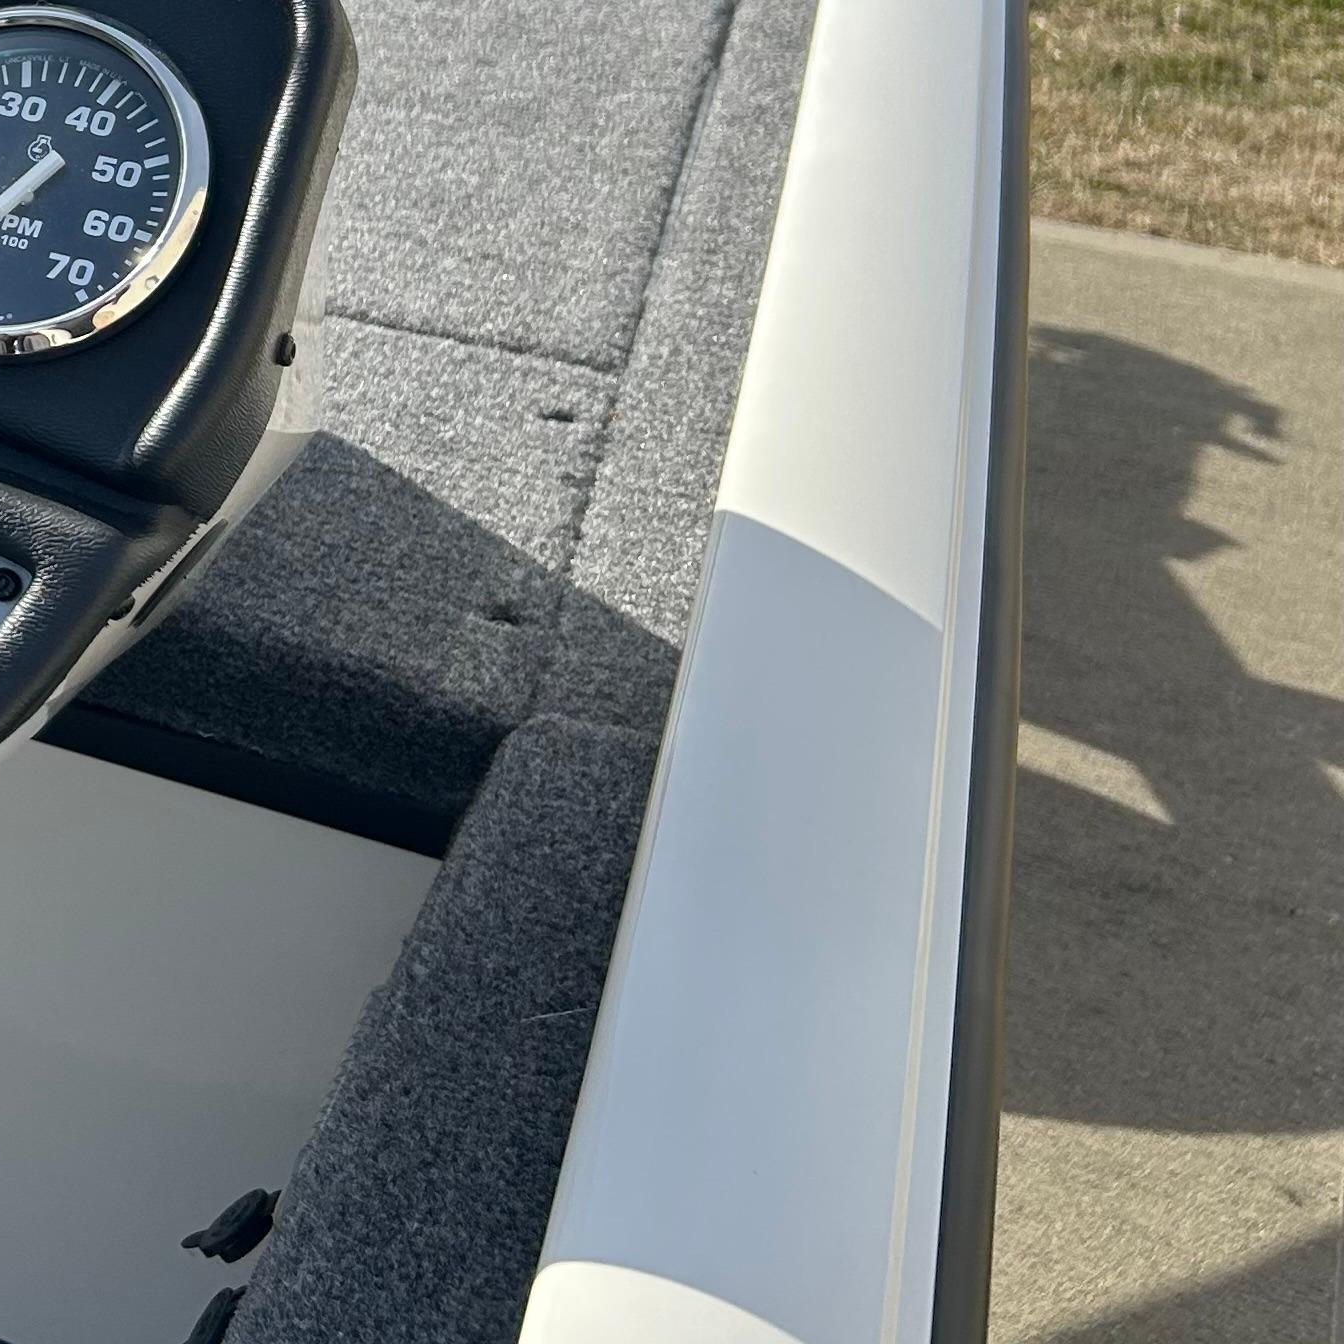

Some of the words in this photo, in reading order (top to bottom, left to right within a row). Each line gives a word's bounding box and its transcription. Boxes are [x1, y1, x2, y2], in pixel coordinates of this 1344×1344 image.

[64, 106, 116, 137] 40
[91, 155, 142, 188] 50
[0, 234, 29, 250] 100
[83, 209, 134, 243] 60
[46, 251, 95, 286] 70
